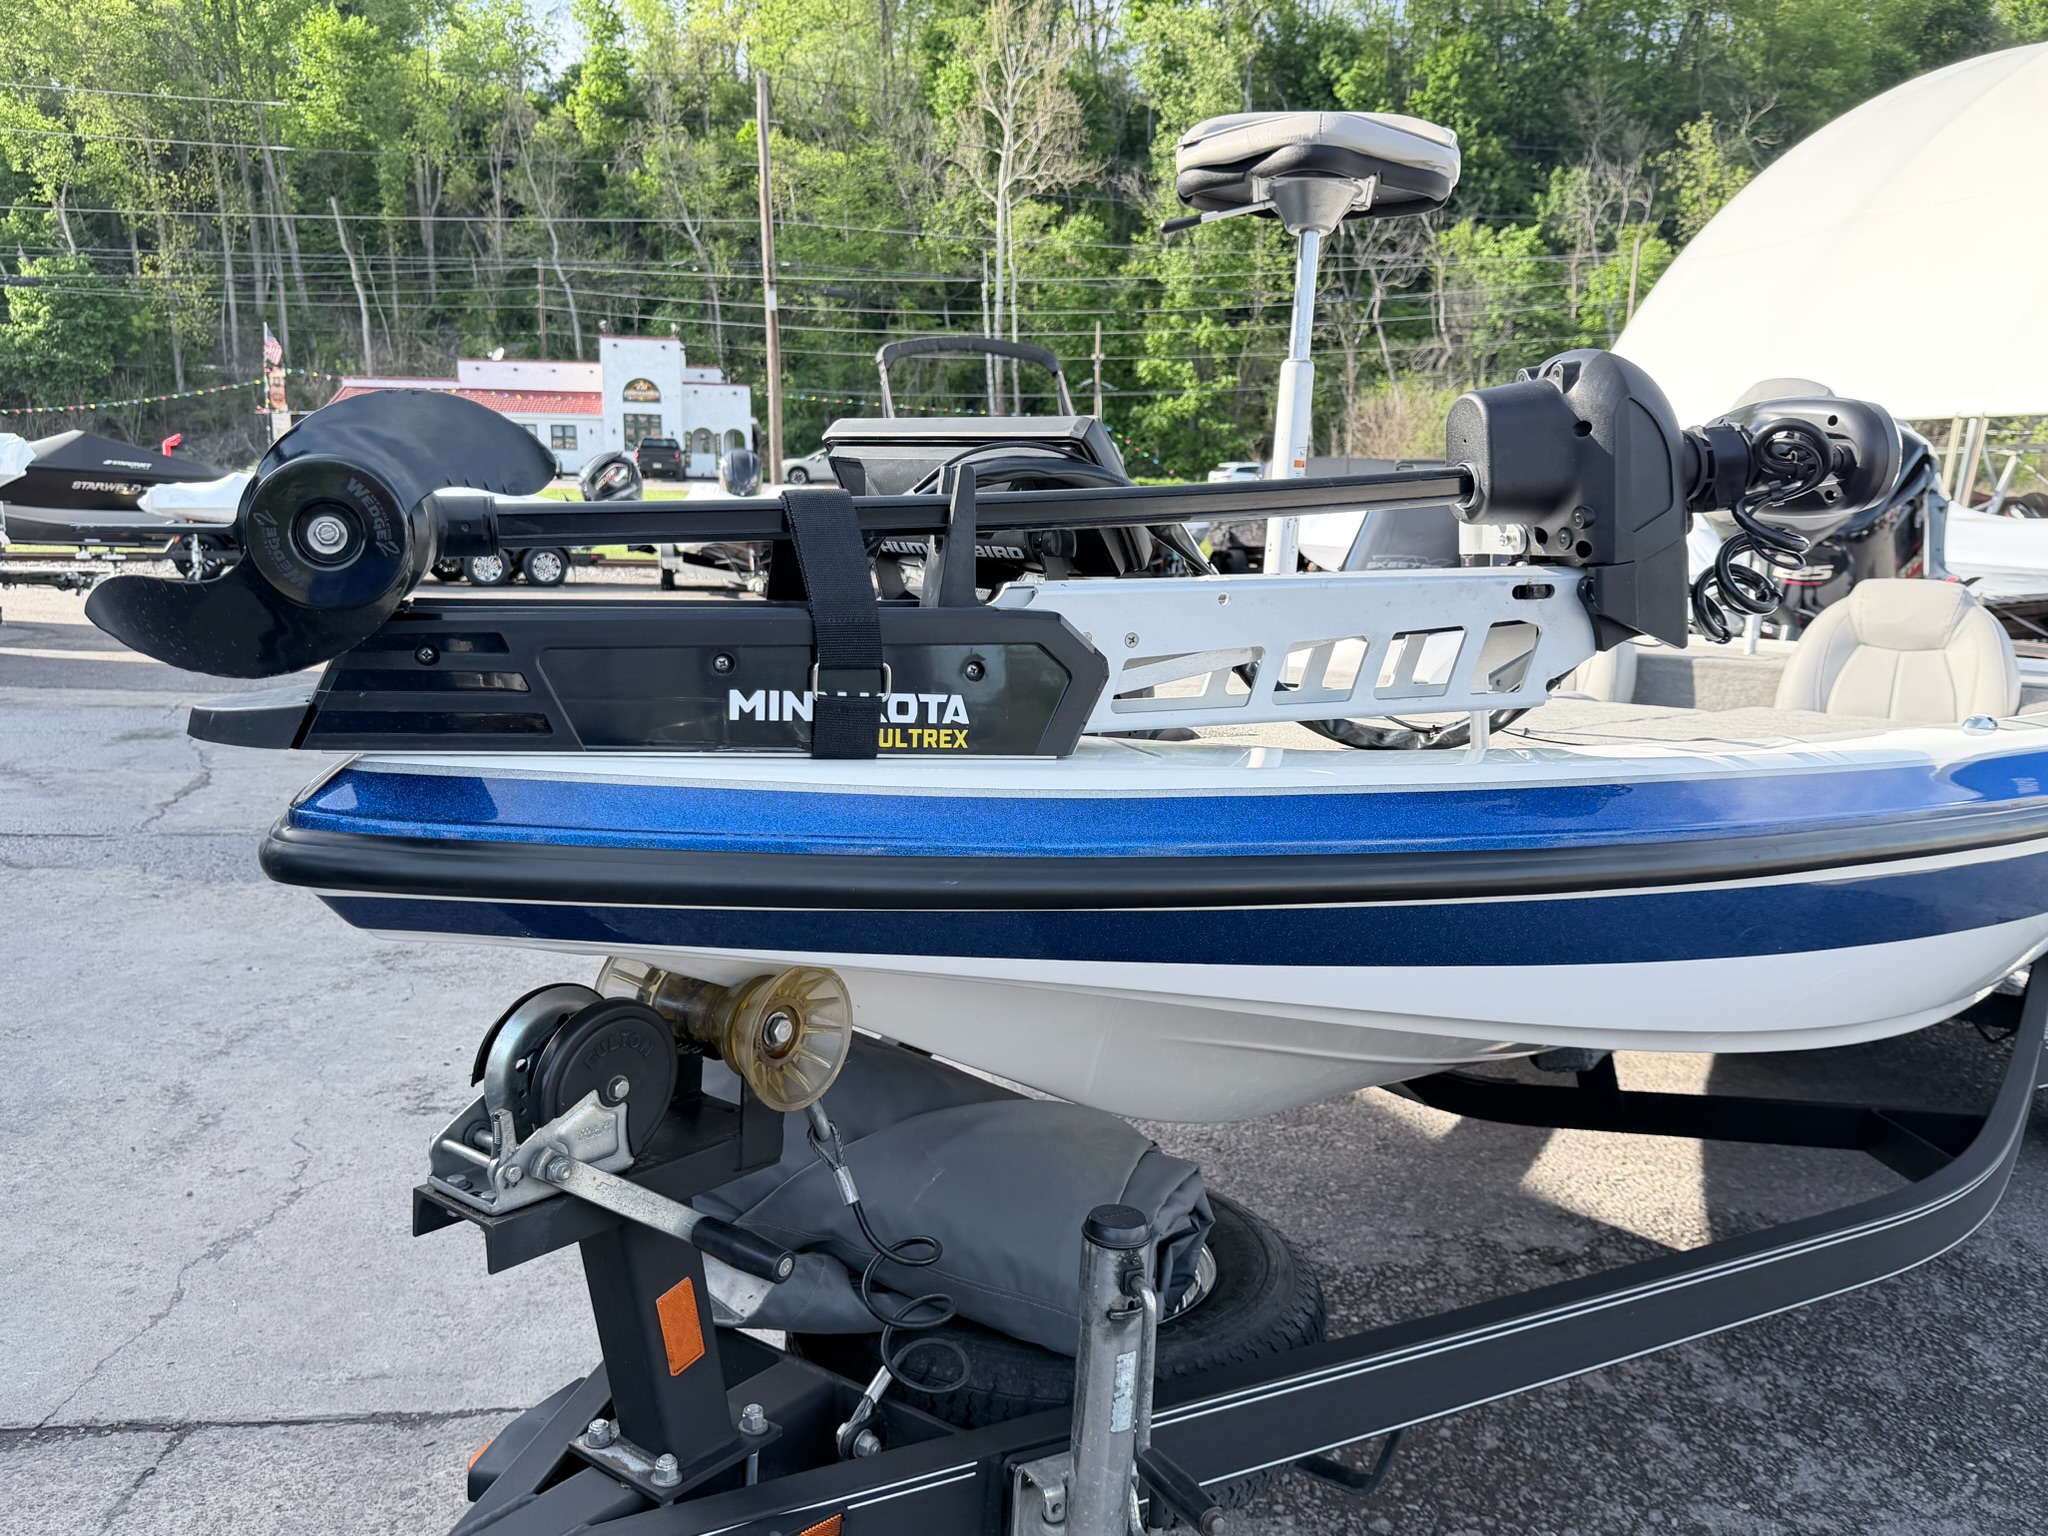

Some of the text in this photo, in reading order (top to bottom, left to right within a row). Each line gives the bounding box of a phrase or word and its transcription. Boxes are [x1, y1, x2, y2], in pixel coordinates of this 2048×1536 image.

[347, 477, 388, 541] WEDGE
[880, 541, 1025, 560] HUMBIRD
[878, 728, 969, 749] ULTREX
[583, 1029, 655, 1071] FULTON
